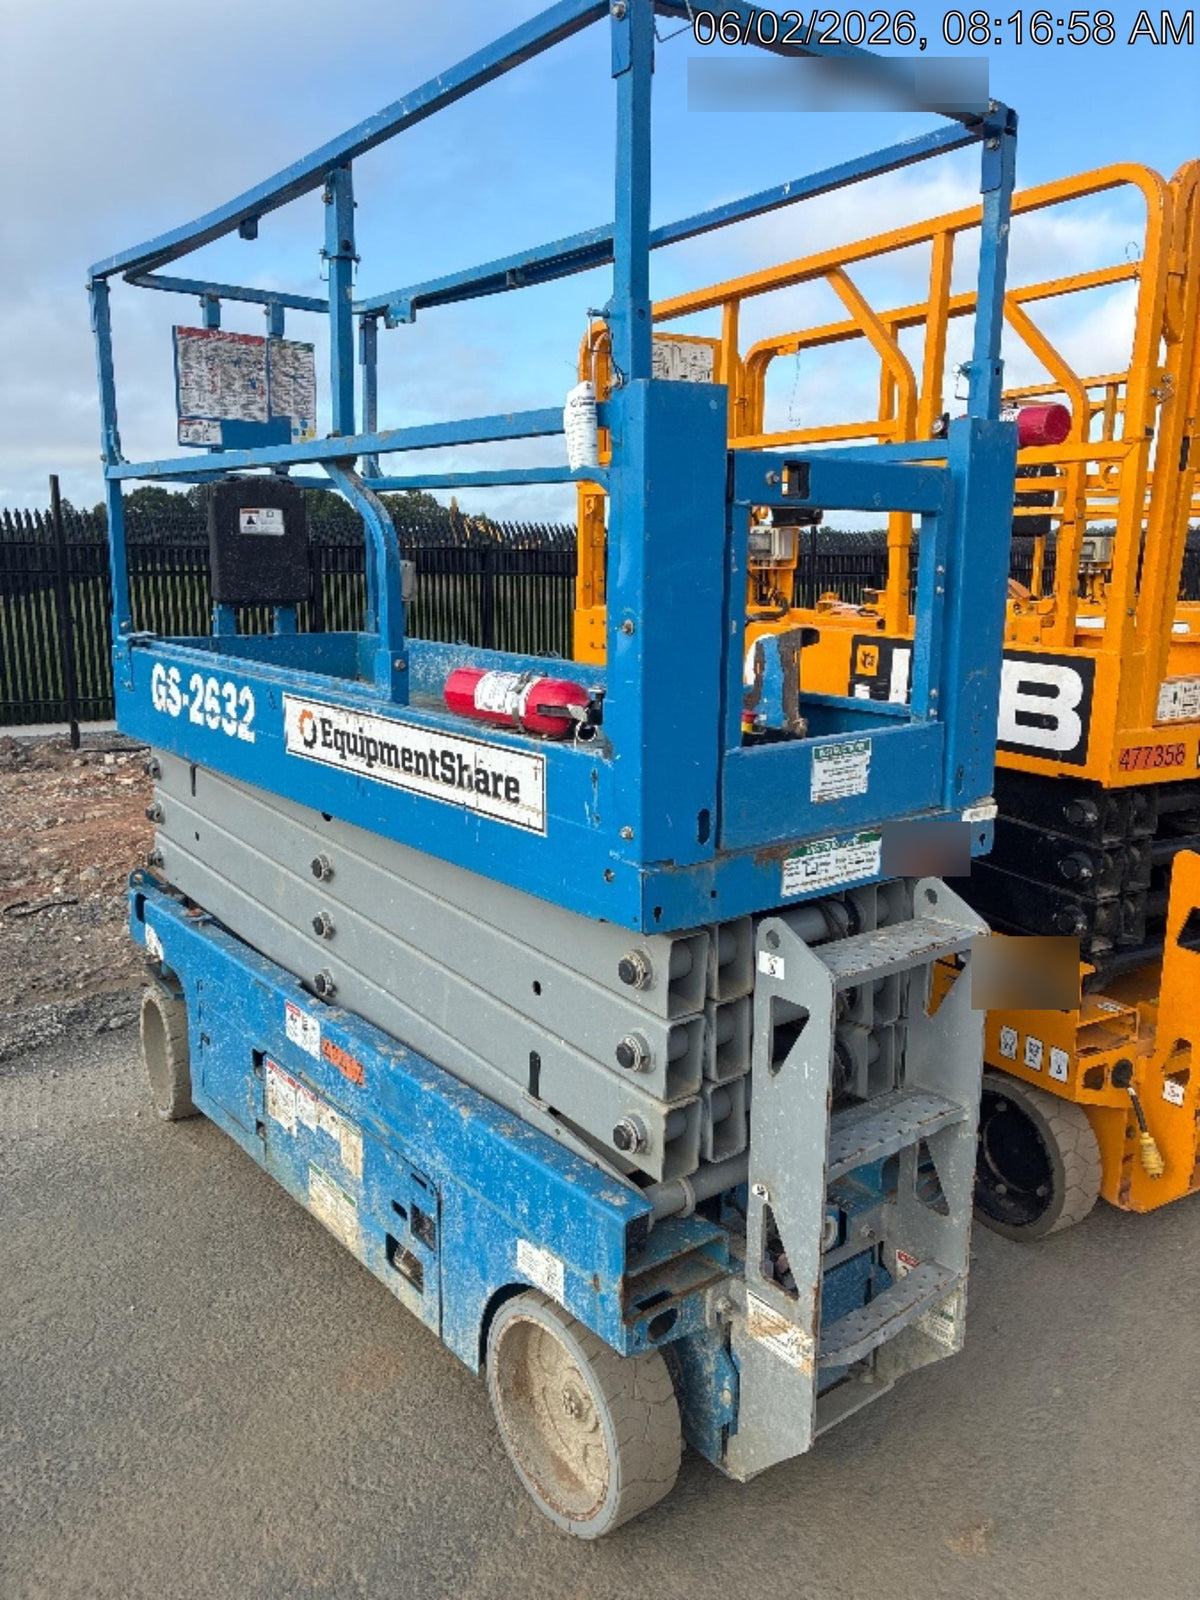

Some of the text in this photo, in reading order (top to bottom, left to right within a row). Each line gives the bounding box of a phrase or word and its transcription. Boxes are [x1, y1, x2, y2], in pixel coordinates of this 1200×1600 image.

[151, 662, 256, 744] GS-2632
[854, 646, 1084, 751] JB
[320, 717, 521, 804] EquipmentShare
